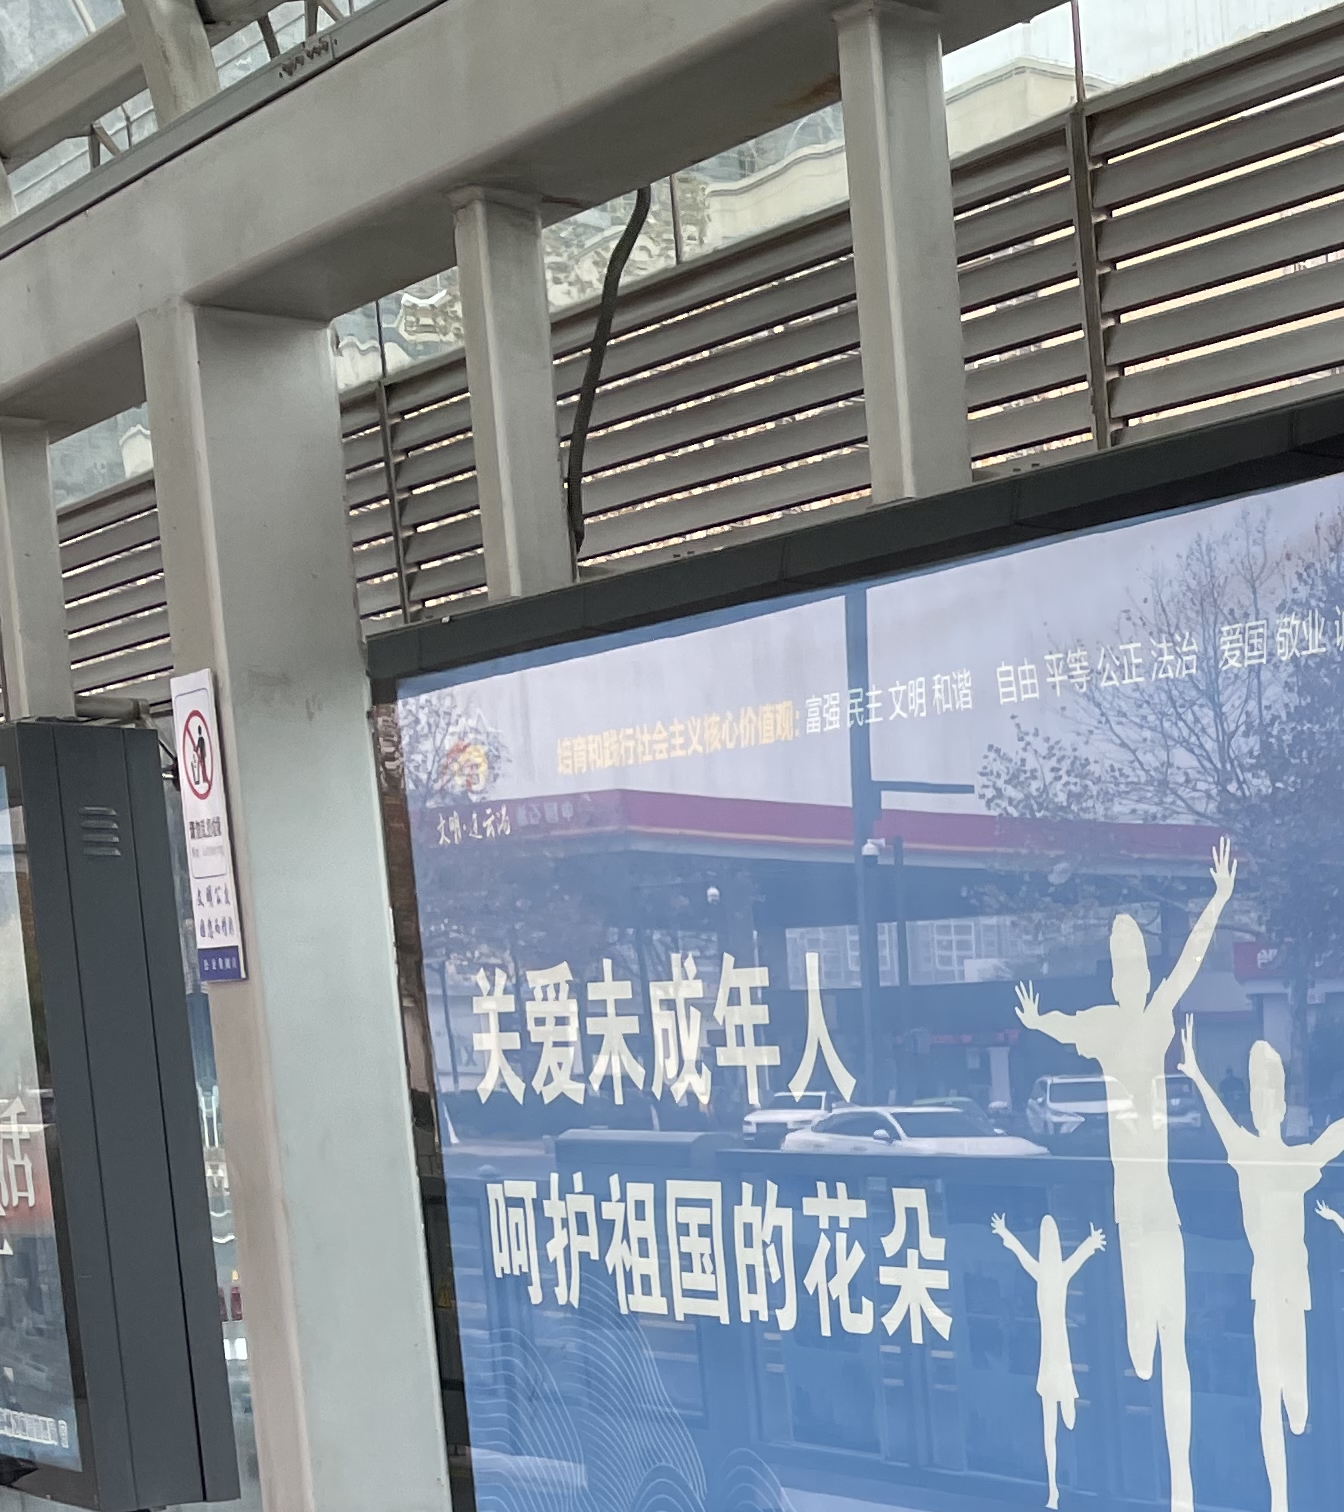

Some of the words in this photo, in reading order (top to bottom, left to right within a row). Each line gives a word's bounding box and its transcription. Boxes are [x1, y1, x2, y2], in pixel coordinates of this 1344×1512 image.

[473, 951, 857, 1105] 关爱未成年人
[486, 1171, 953, 1344] 呵护祖国的花朵
